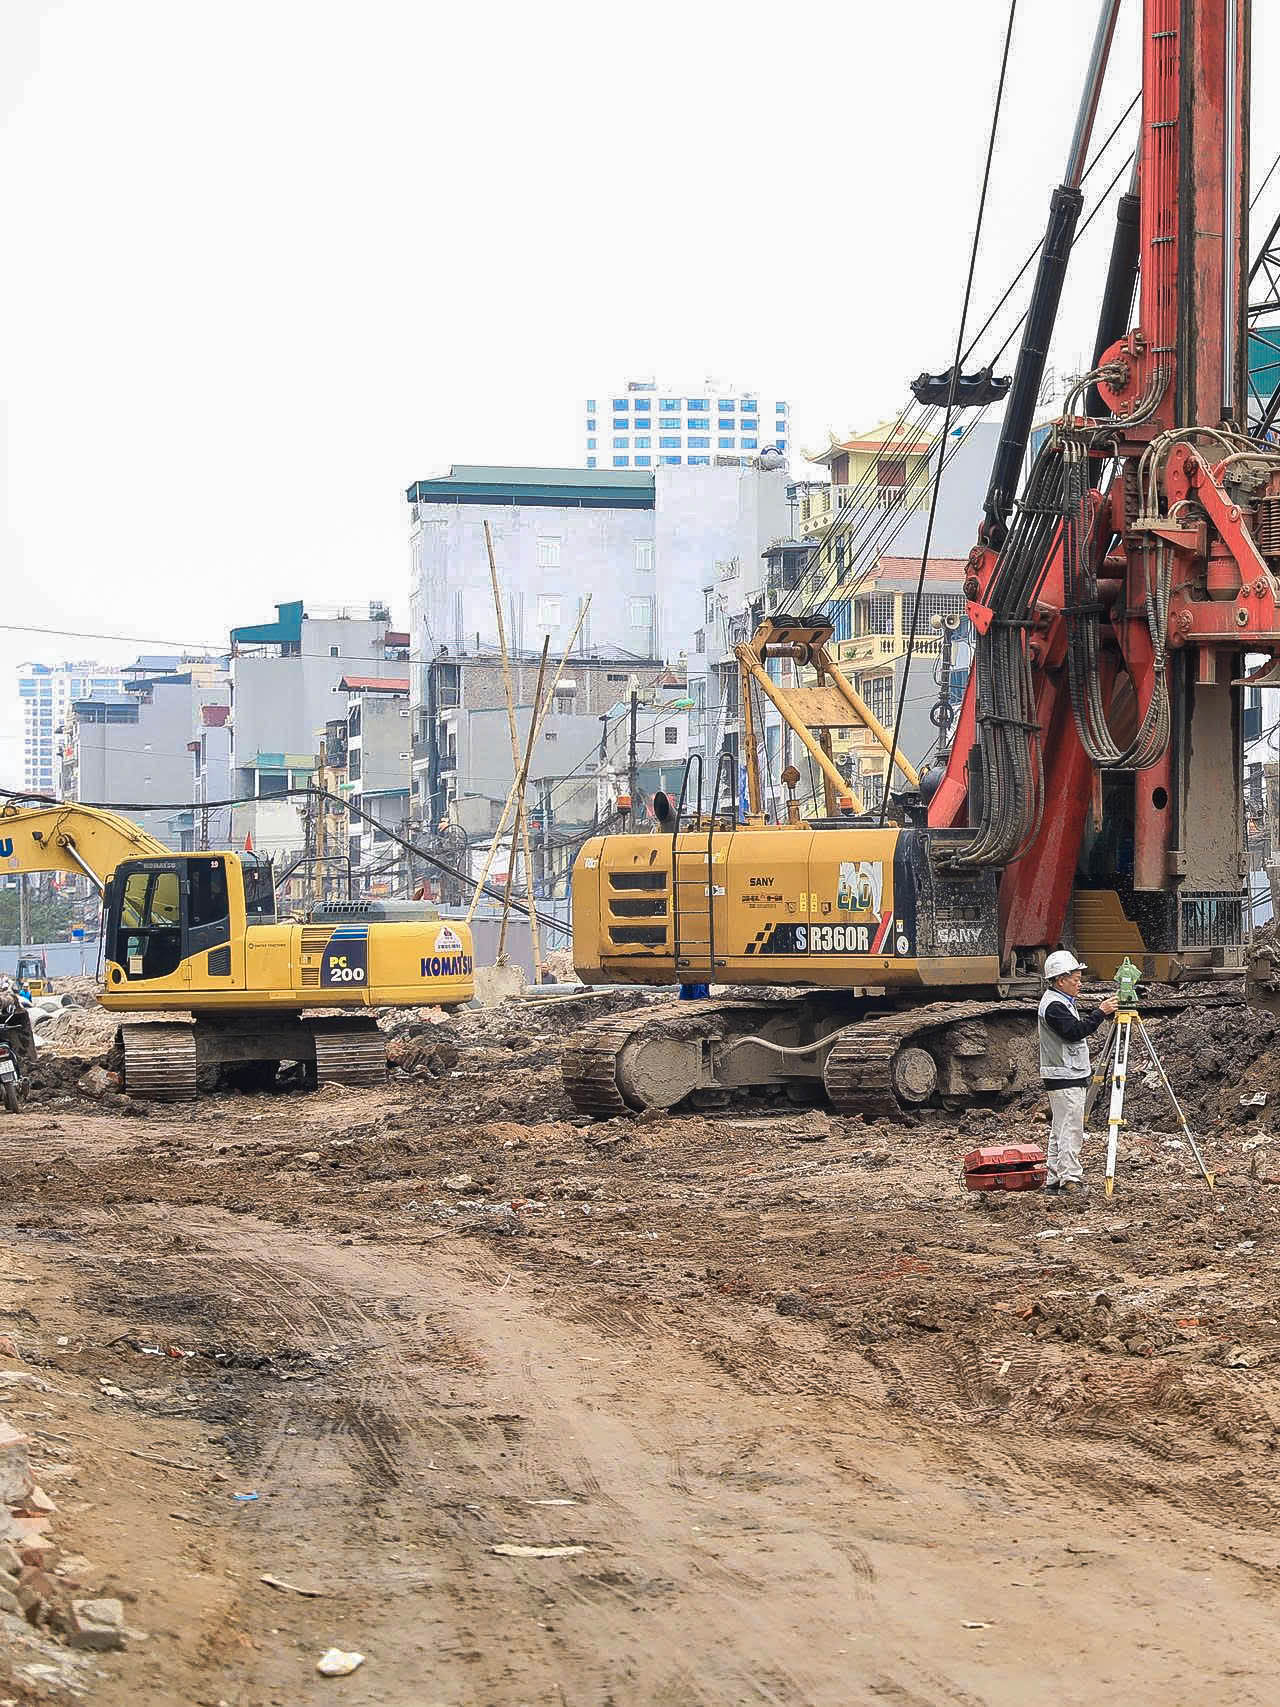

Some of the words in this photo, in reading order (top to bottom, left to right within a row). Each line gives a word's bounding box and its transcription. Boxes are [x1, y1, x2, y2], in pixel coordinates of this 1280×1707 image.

[749, 877, 775, 887] SANY
[795, 926, 869, 951] SR360R
[937, 927, 982, 943] SANY
[329, 956, 348, 968] PC
[420, 955, 473, 977] KOMATSU
[330, 967, 365, 983] 200
